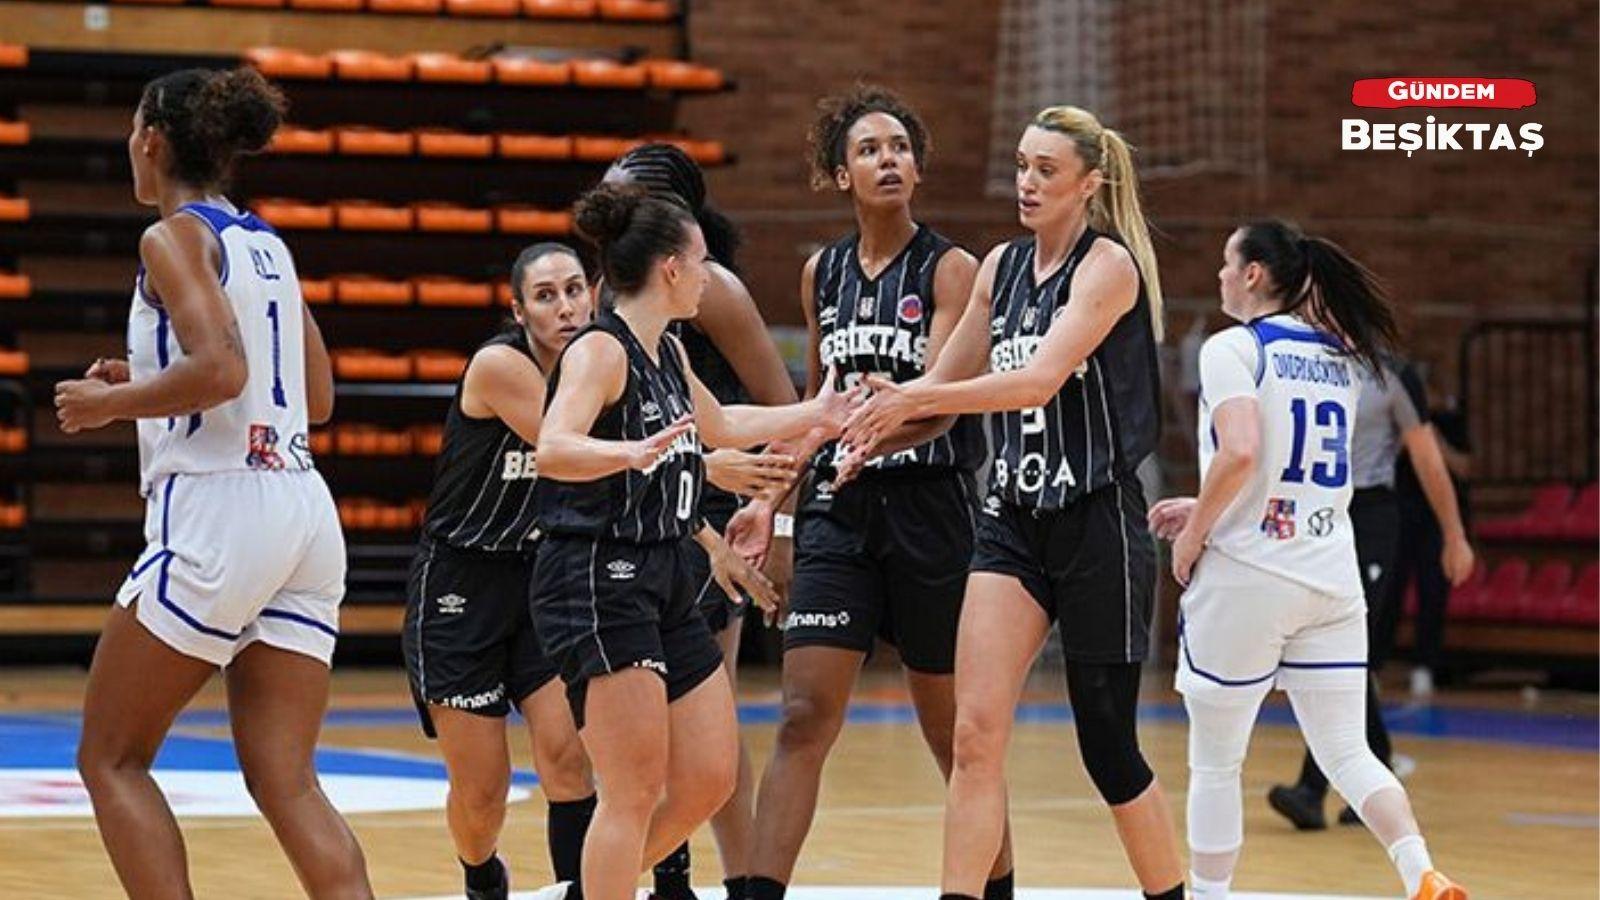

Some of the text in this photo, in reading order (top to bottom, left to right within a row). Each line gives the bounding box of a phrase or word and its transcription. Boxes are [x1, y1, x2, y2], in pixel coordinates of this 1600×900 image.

[266, 301, 287, 408] 1
[501, 450, 538, 480] BE
[1280, 397, 1348, 488] 13
